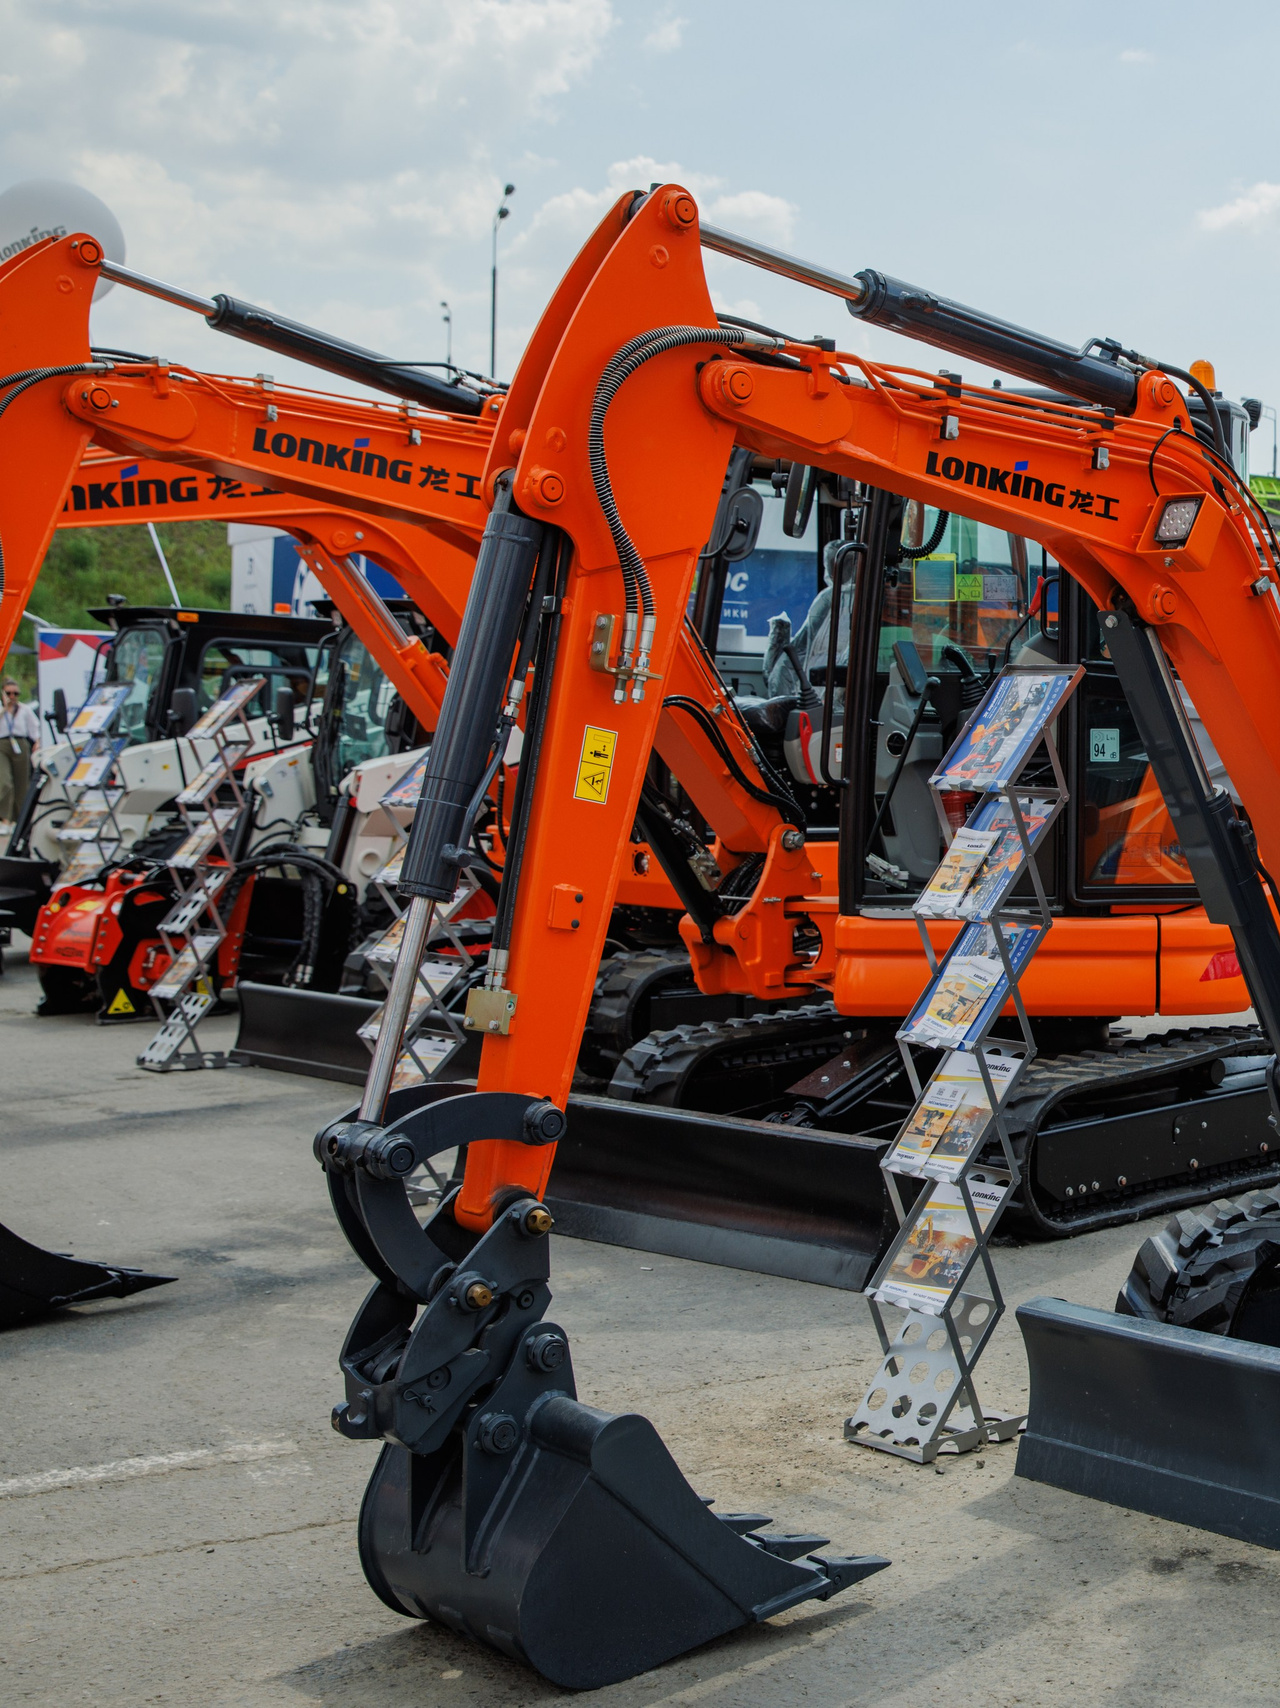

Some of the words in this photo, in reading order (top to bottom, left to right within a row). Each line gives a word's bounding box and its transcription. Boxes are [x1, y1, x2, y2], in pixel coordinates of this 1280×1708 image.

[0, 226, 67, 261] ONKING
[419, 464, 482, 501] 龙工
[1068, 488, 1120, 521] 龙工
[1094, 743, 1106, 757] 94
[985, 1063, 1012, 1073] ONKING
